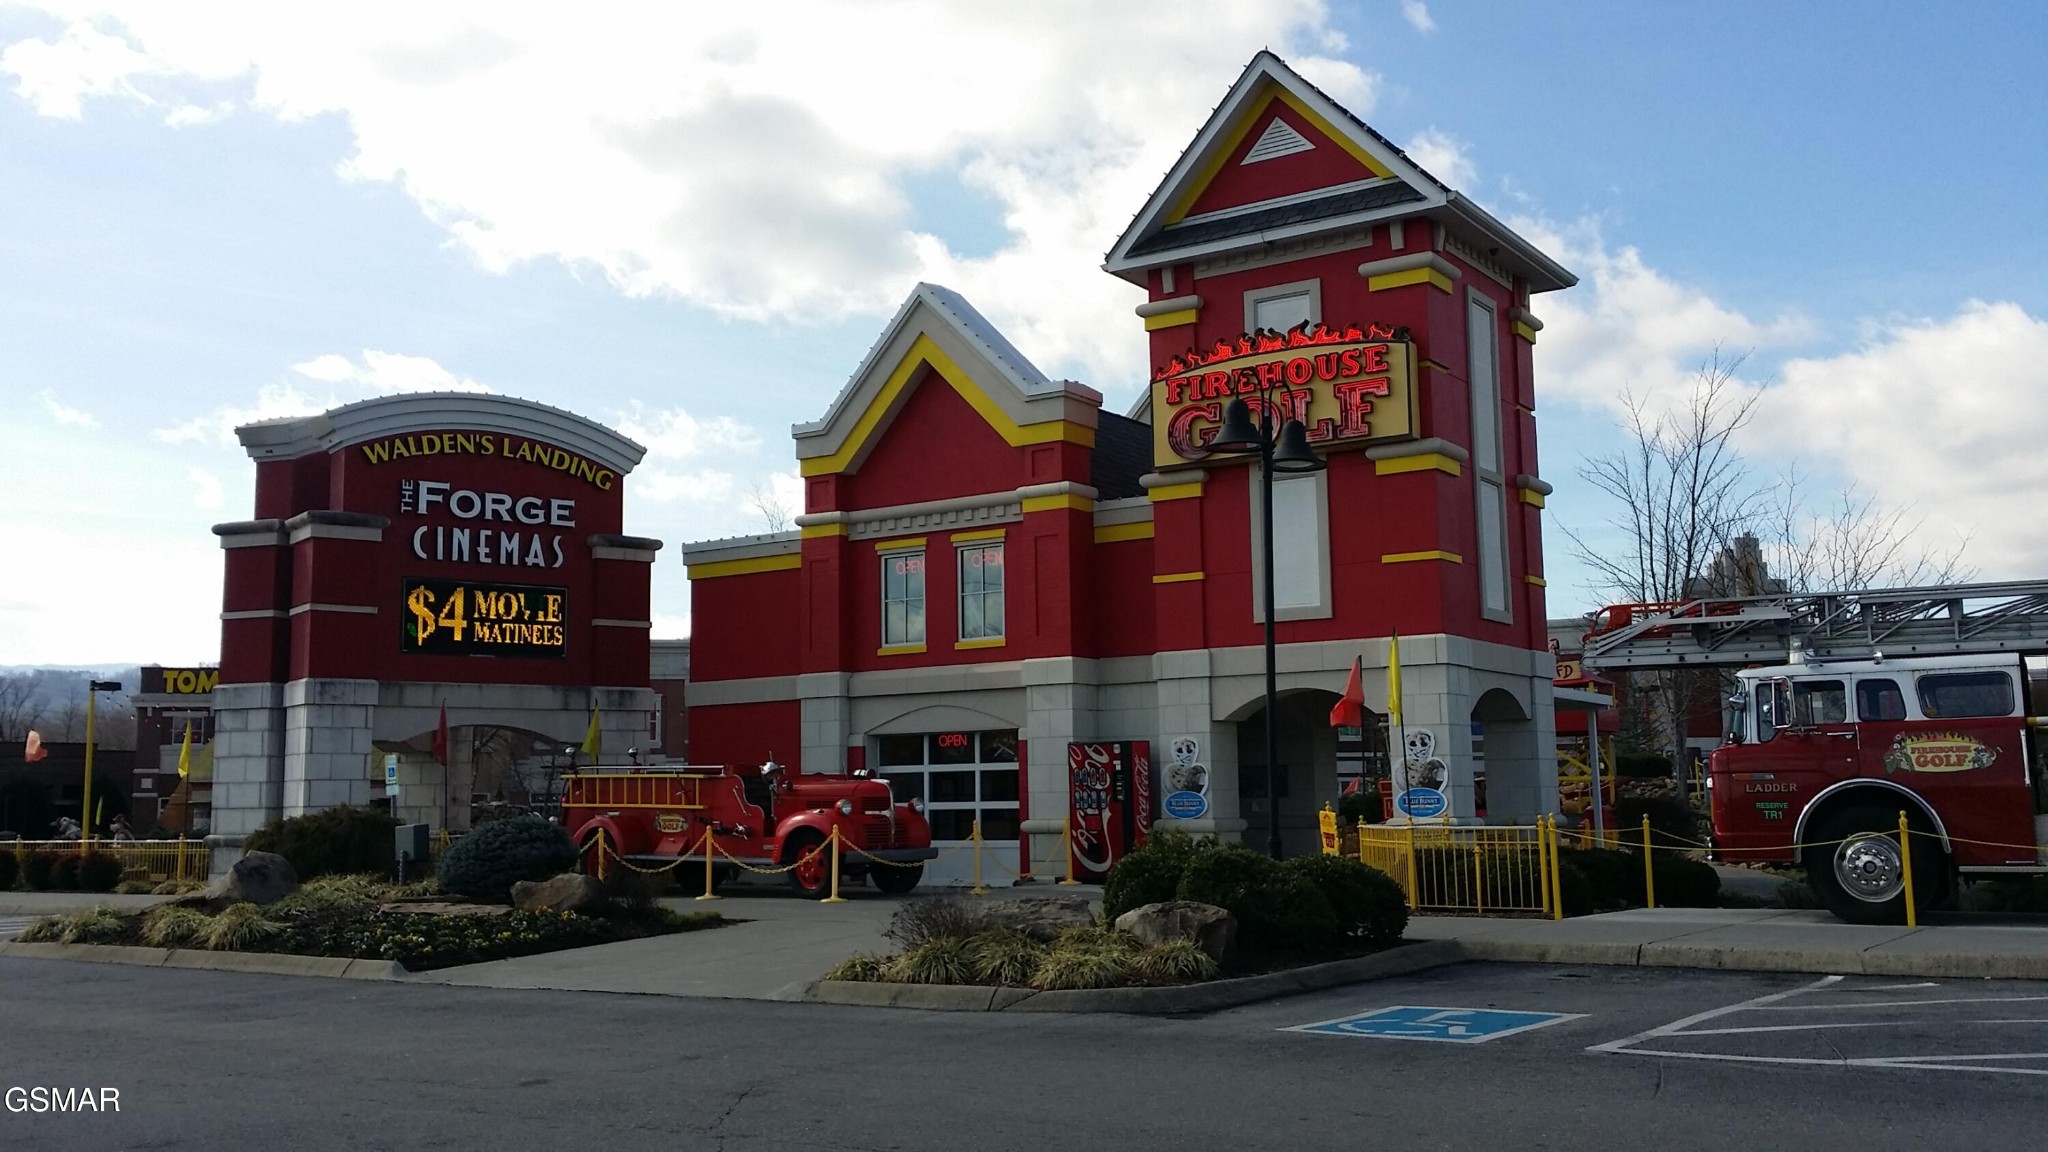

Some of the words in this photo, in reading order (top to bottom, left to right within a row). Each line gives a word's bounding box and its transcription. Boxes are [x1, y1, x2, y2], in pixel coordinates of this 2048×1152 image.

[1166, 344, 1389, 405] FIREHOUSE
[362, 434, 495, 465] WALDEN'S
[502, 438, 615, 491] LANDING
[401, 479, 414, 513] THE
[416, 480, 576, 529] FORGE
[413, 525, 564, 568] CINEMAS
[407, 585, 468, 646] $4
[473, 621, 563, 646] MATINEES
[938, 734, 968, 747] OPEN
[1910, 745, 1972, 755] FIREHOUSE
[1914, 754, 1969, 768] GOLF
[1134, 753, 1150, 834] Coca-Cola
[1745, 783, 1798, 793] LADDER
[1763, 810, 1783, 819] TR1
